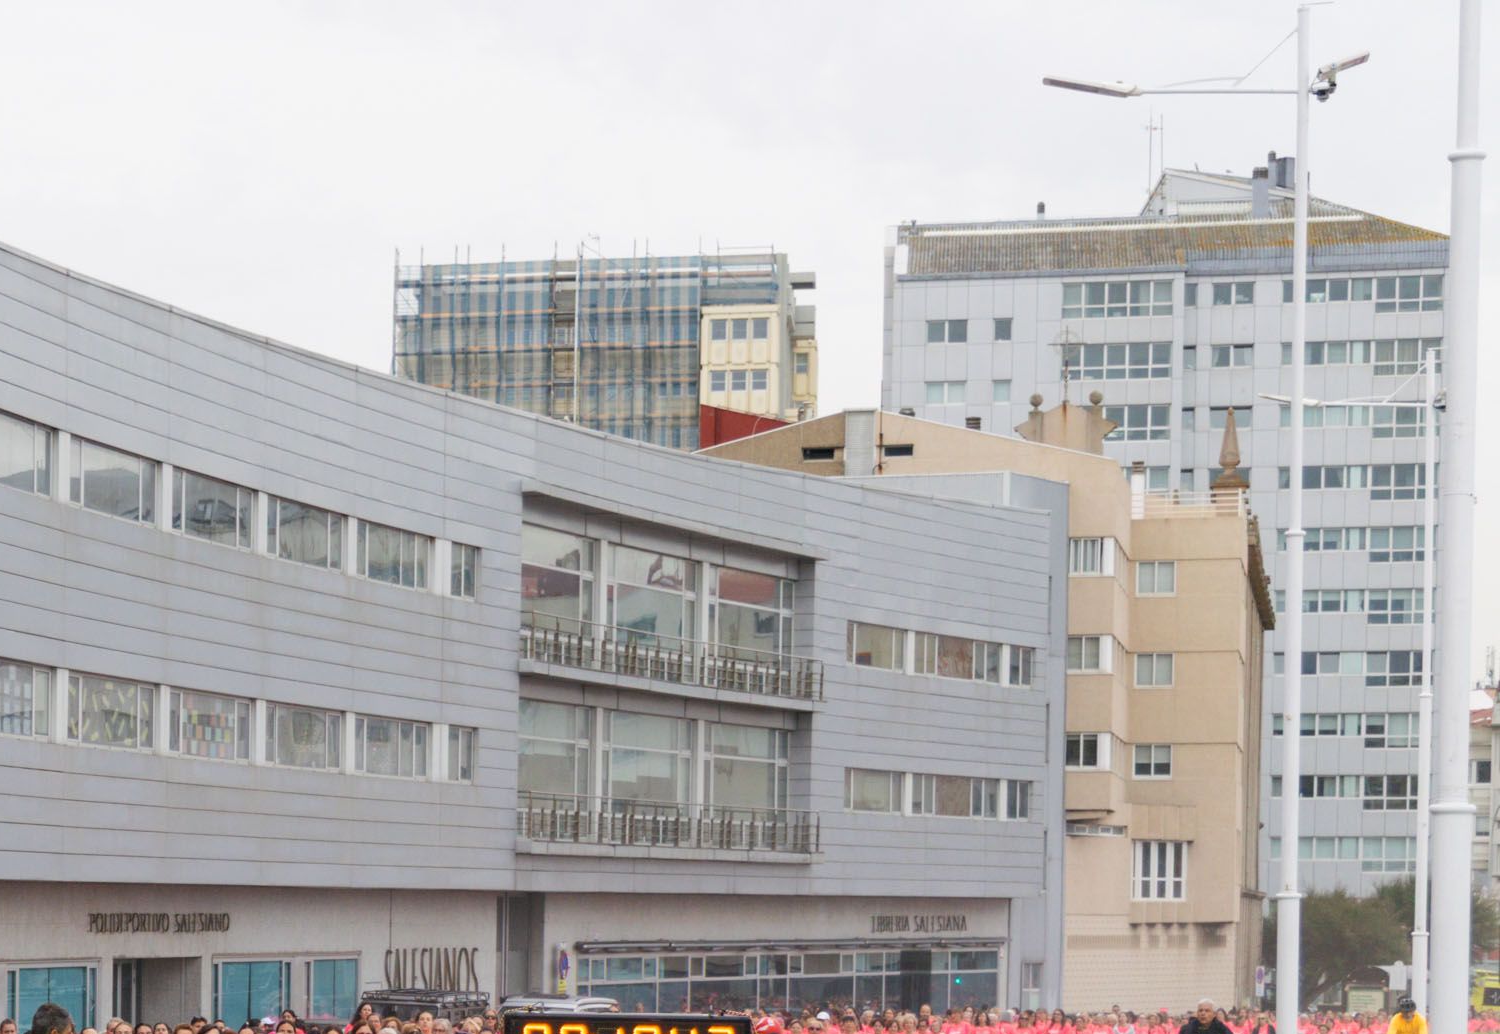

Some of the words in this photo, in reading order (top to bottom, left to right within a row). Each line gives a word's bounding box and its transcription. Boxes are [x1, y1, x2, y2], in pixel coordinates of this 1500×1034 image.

[87, 913, 170, 933] POLIDEPORTIVO
[174, 913, 230, 932] SALESIANO
[384, 947, 479, 991] SALESIANOS
